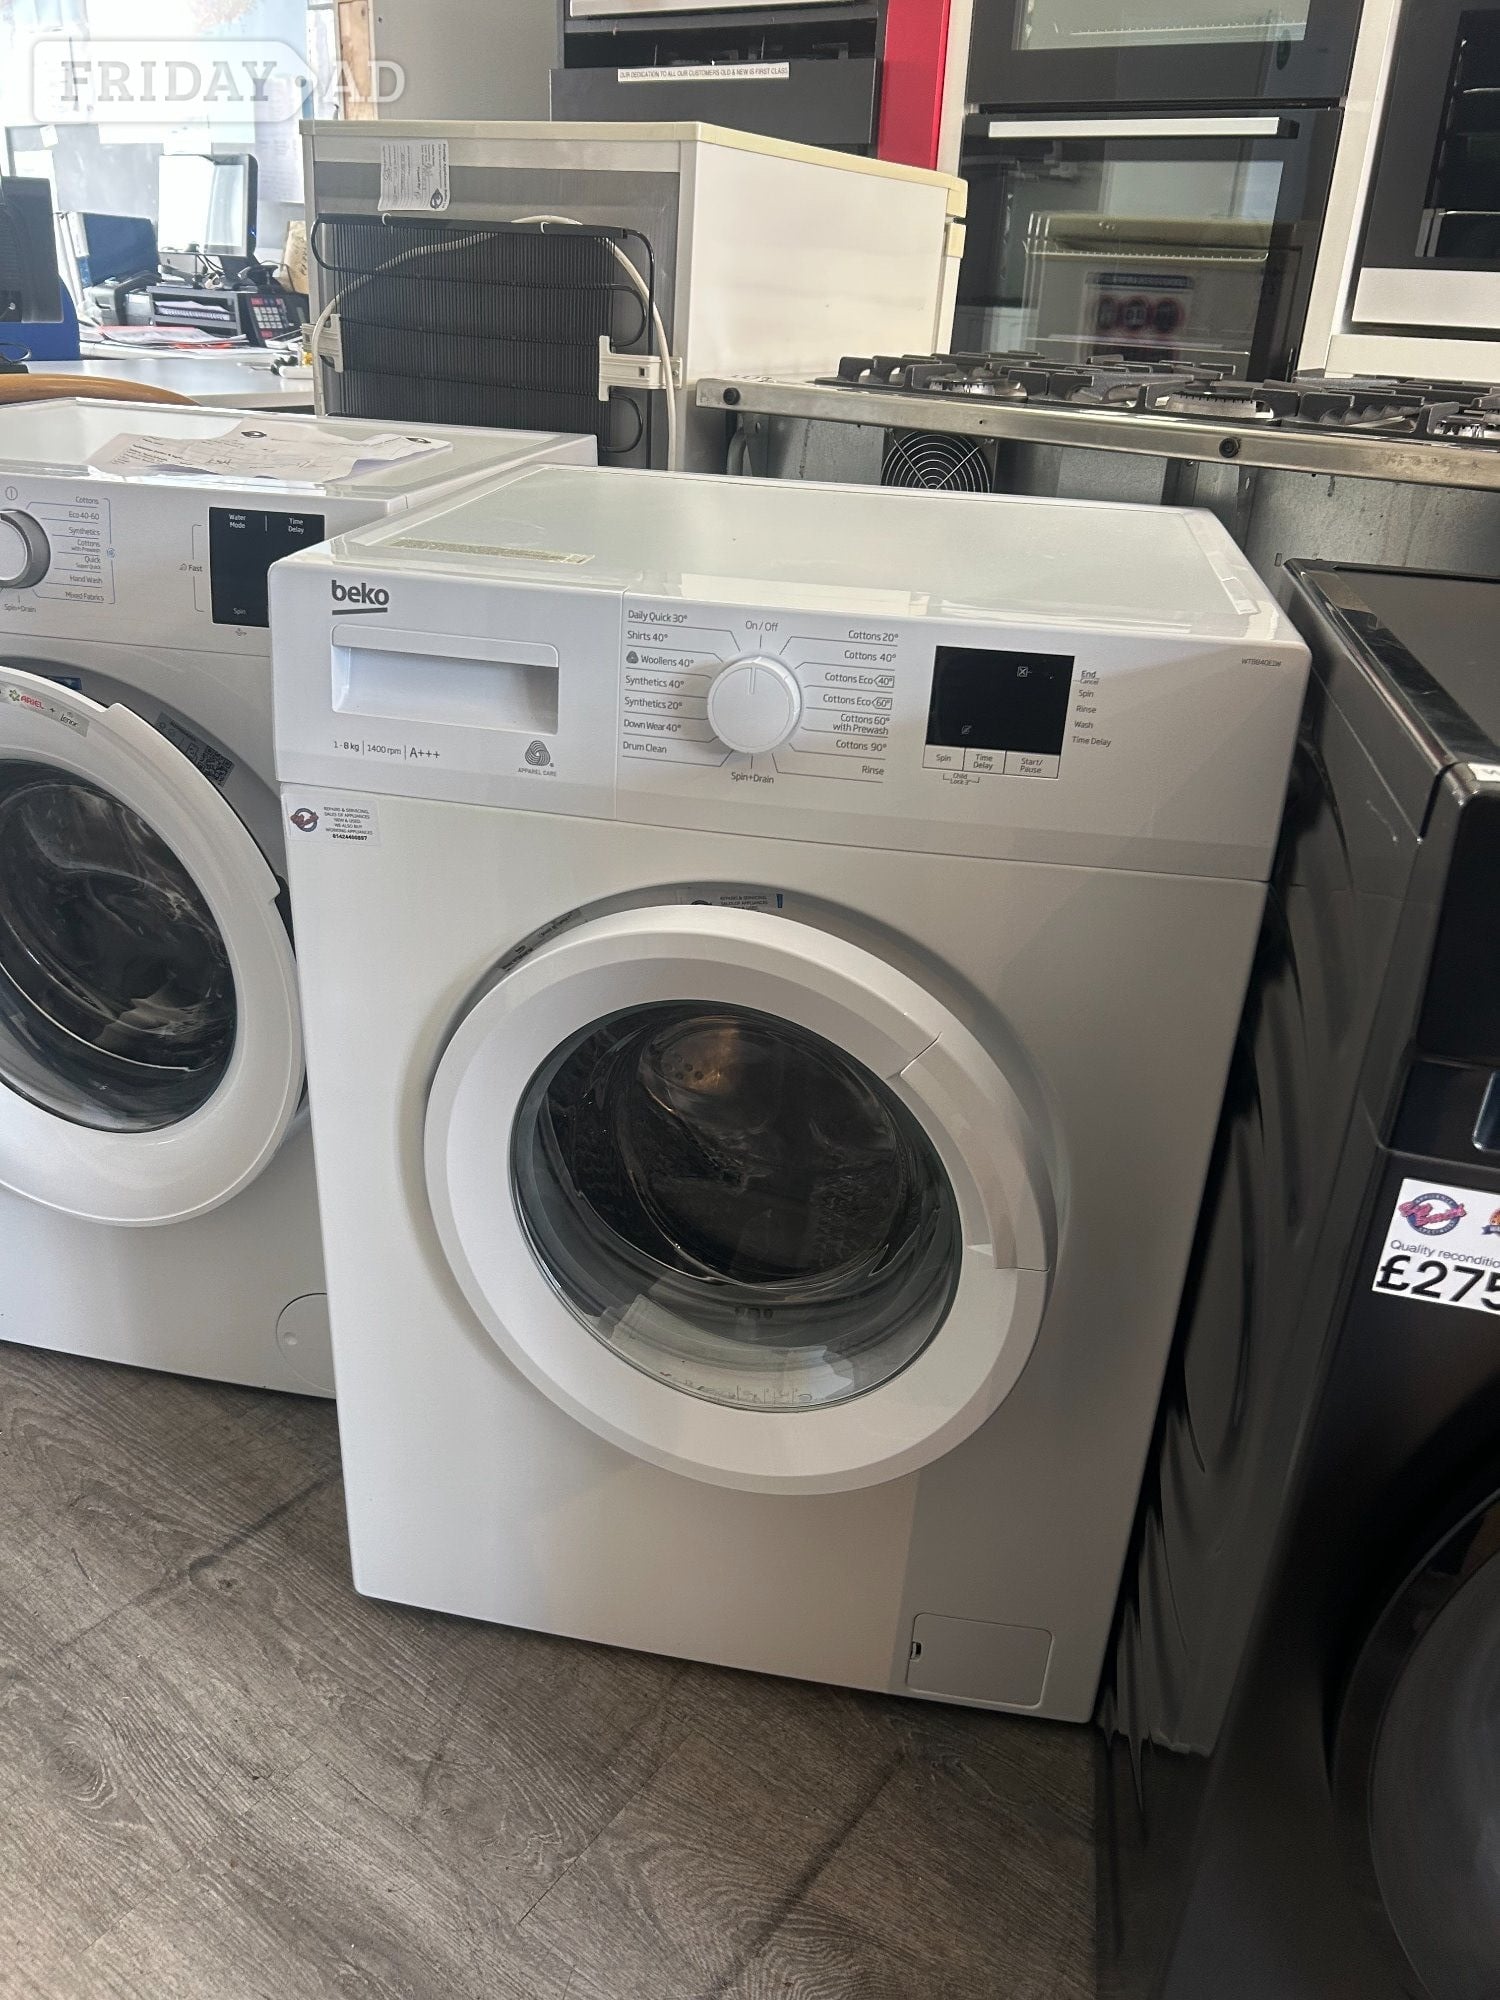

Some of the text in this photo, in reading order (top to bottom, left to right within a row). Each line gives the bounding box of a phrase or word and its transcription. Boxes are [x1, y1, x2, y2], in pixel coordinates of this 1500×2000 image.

[688, 69, 720, 77] CUSTOMERS
[737, 68, 748, 76] NEW
[75, 496, 99, 504] Cottons
[68, 511, 100, 520] Eco 40-60
[229, 521, 246, 529] Mode
[288, 526, 304, 534] Delay
[68, 527, 100, 536] Synthetics
[77, 540, 100, 548] Cottons
[84, 556, 101, 564] Quick
[70, 575, 87, 583] Hand
[65, 591, 104, 602] Mixed Fabrics
[331, 580, 390, 606] beko
[4, 603, 37, 613] Spin+Drain
[628, 609, 688, 623] Daily Quick 30°
[745, 620, 758, 630] On
[764, 621, 778, 632] Off
[627, 630, 668, 642] Shirts 40°
[848, 630, 899, 643] Cottons 20°
[640, 654, 694, 668] Woollens 40°
[844, 650, 897, 663] Cottons 40°
[824, 672, 893, 687] Cottons Eco 40°
[1080, 670, 1096, 679] End
[625, 675, 684, 689] Synthetics 40°
[1078, 689, 1094, 699] Spin
[624, 696, 683, 710] Synthetics 20°
[822, 694, 892, 709] Cottons Eco 60°
[20, 695, 44, 710] ARIEL
[60, 713, 78, 727] Lenor
[1076, 704, 1097, 714] Rinse
[623, 719, 682, 732] Down Wear 40°
[840, 714, 891, 726] Cottons 60°
[1074, 721, 1094, 729] Wash
[833, 722, 889, 736] with Prewash
[623, 741, 667, 753] Drum Clean
[835, 739, 887, 752] Cottons 90°
[1072, 735, 1111, 748] Time Delay
[350, 743, 360, 752] kg
[367, 743, 402, 756] 1400 rpm
[409, 747, 440, 759] A+++
[936, 753, 952, 763] Spin
[975, 753, 993, 762] Time
[1021, 757, 1043, 766] Start/
[862, 765, 885, 776] Rinse
[973, 761, 994, 771] Delay
[1019, 765, 1042, 774] Pause
[518, 767, 557, 777] APPAREL CARE
[731, 771, 774, 784] Spin+Drain
[952, 772, 968, 780] Child
[1390, 1239, 1436, 1258] Quality
[1376, 1254, 1500, 1312] £275
